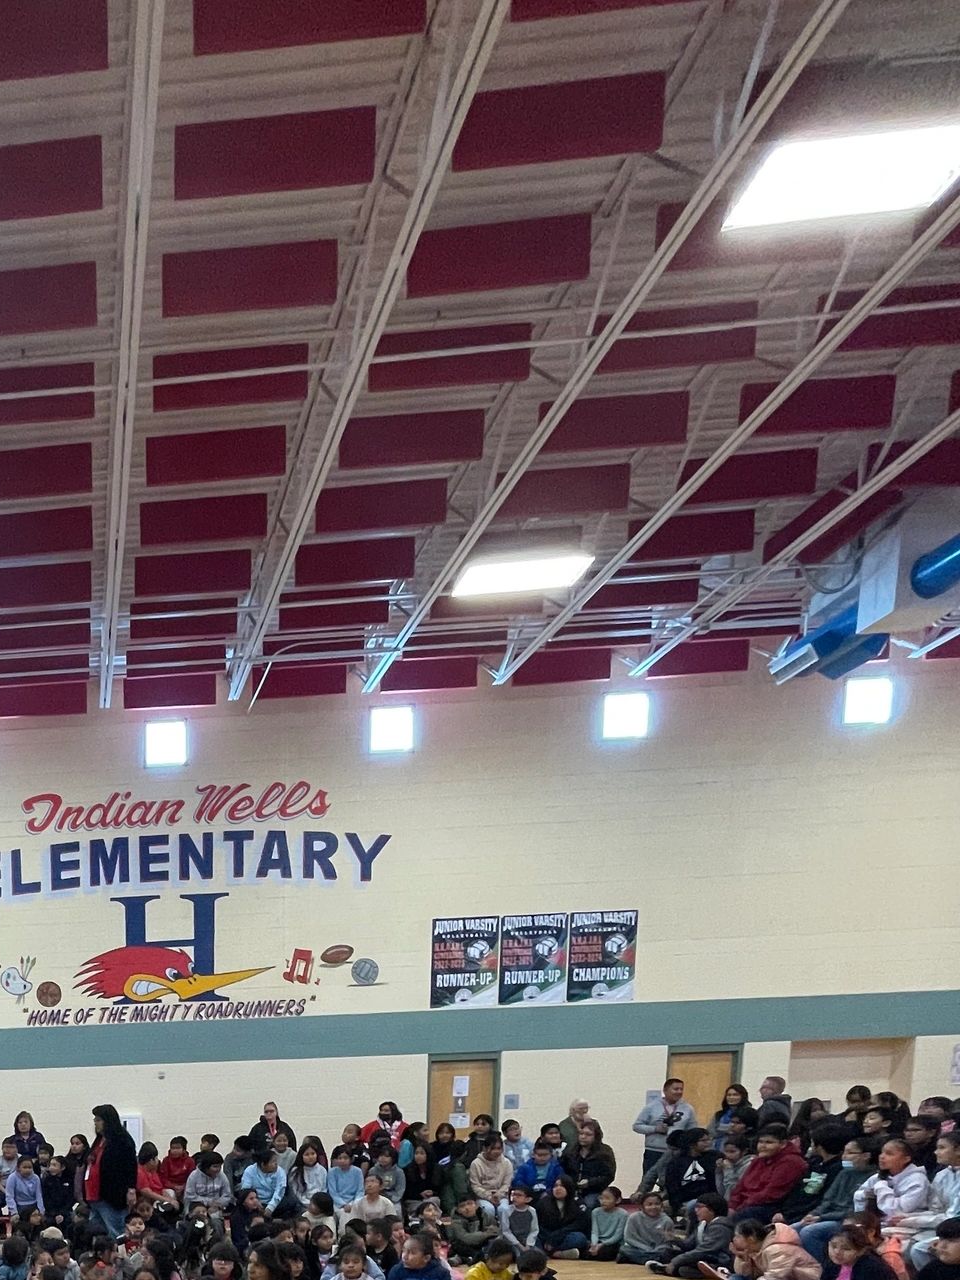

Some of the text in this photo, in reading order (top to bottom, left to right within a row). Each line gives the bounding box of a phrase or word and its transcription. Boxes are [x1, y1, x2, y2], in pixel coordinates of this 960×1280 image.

[21, 780, 332, 834] Indian Wells
[434, 918, 498, 936] JUNIOR VARSITY
[503, 914, 567, 932] JUNIOR VARSITY
[572, 911, 637, 928] JUNIOR VARSITY
[436, 972, 493, 988] RUNNER-UP
[504, 969, 561, 985] RUNNER-UP
[573, 966, 630, 982] CHAMPIONS
[74, 1007, 97, 1024] OF
[99, 1005, 130, 1023] THE
[131, 1001, 193, 1022] MIGHTY
